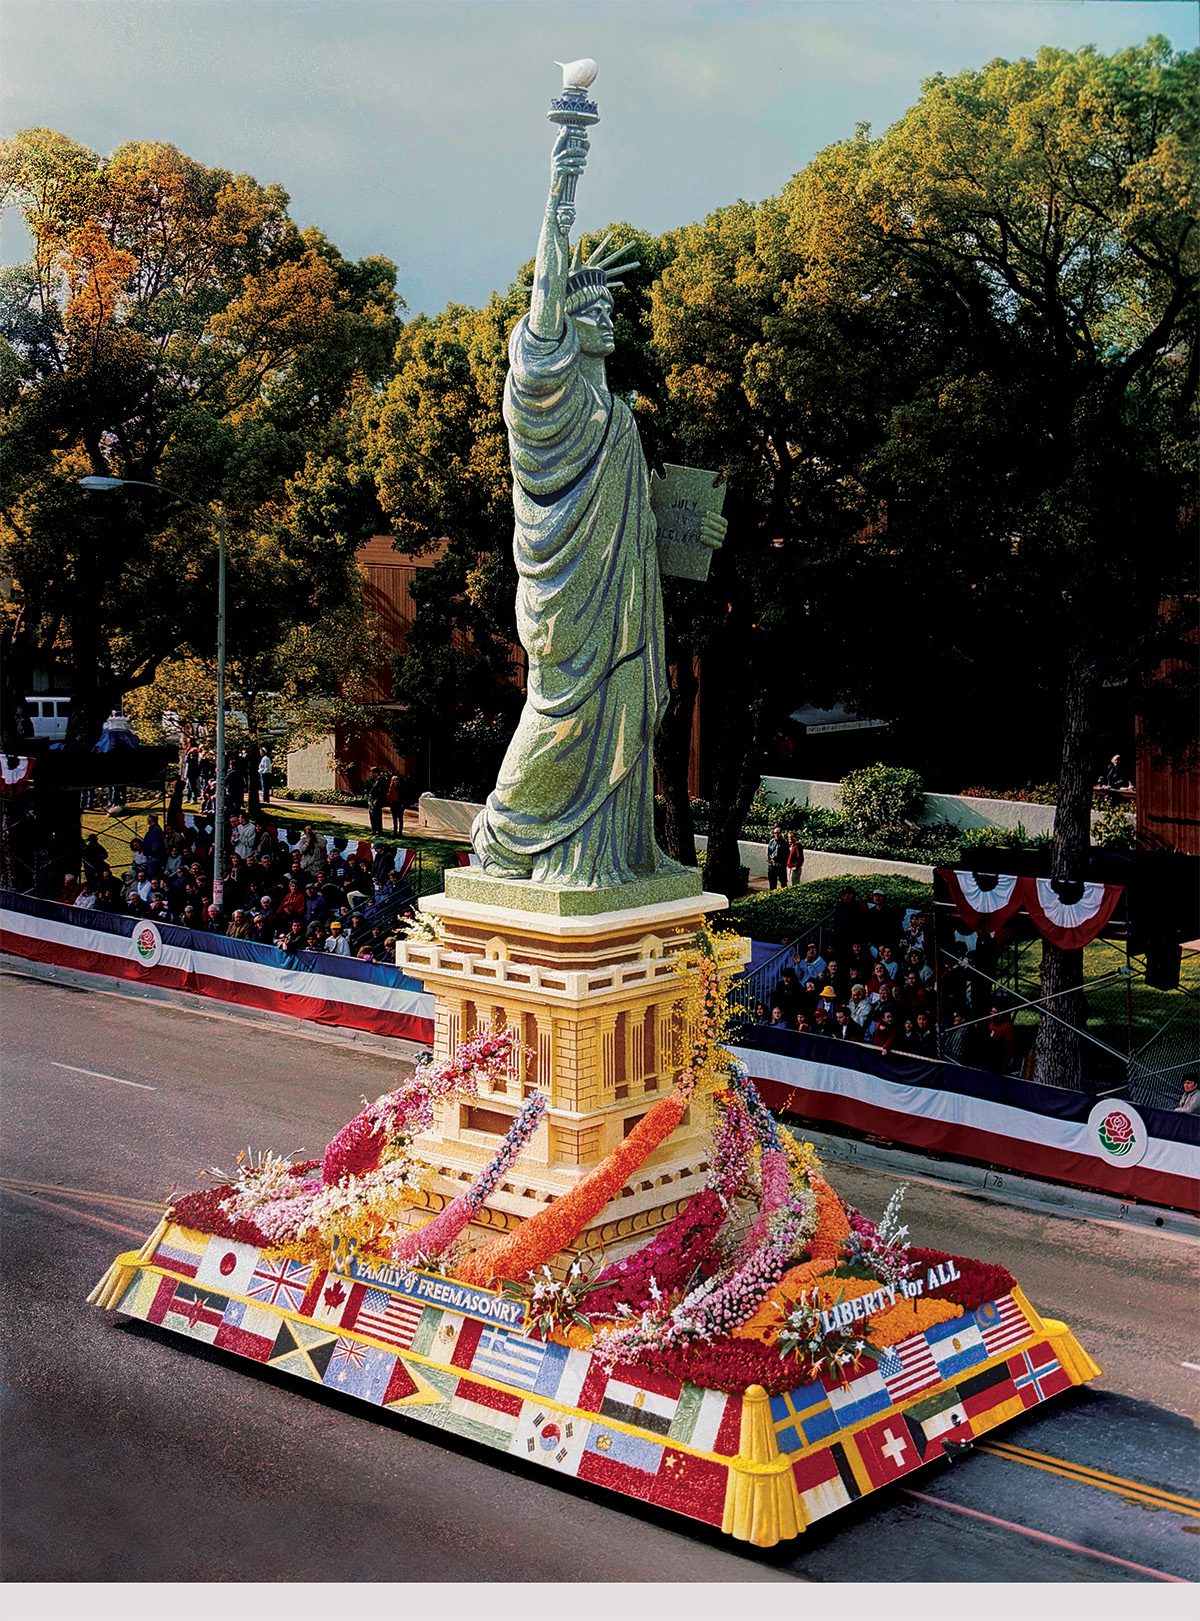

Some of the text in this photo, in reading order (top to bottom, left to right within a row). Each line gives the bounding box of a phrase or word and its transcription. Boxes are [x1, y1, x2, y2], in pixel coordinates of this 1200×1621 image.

[671, 498, 698, 511] JULY
[356, 1261, 521, 1323] FAMILY of FREEMASONRY
[819, 1260, 961, 1335] LIBERTY for ALL
